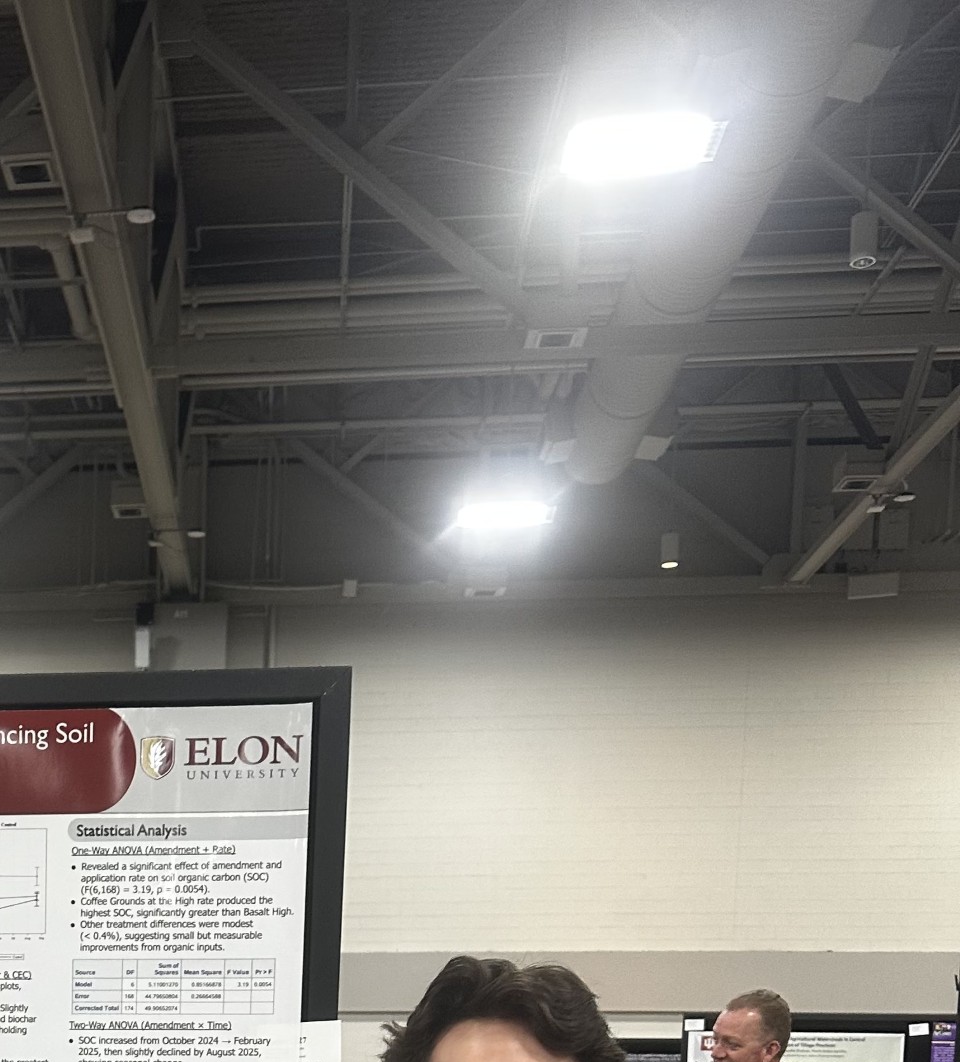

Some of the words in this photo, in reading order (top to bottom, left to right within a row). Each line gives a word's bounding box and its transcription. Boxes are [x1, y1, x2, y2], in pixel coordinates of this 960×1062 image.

[56, 722, 94, 744] Soil
[184, 734, 304, 766] ELON
[186, 767, 300, 780] UNIVERSITY
[77, 824, 135, 837] Statistical
[137, 824, 187, 840] Analysis
[72, 847, 110, 857] One-Way
[112, 846, 143, 856] ANOVA
[145, 846, 200, 856] (Amendment
[213, 845, 236, 856] Rate)
[4, 971, 11, 981] &
[12, 971, 32, 981] CEC)
[69, 1021, 107, 1031] Two-Way
[109, 1021, 139, 1031] ANOVA
[141, 1021, 195, 1031] (Amendment
[207, 1021, 232, 1031] Time)
